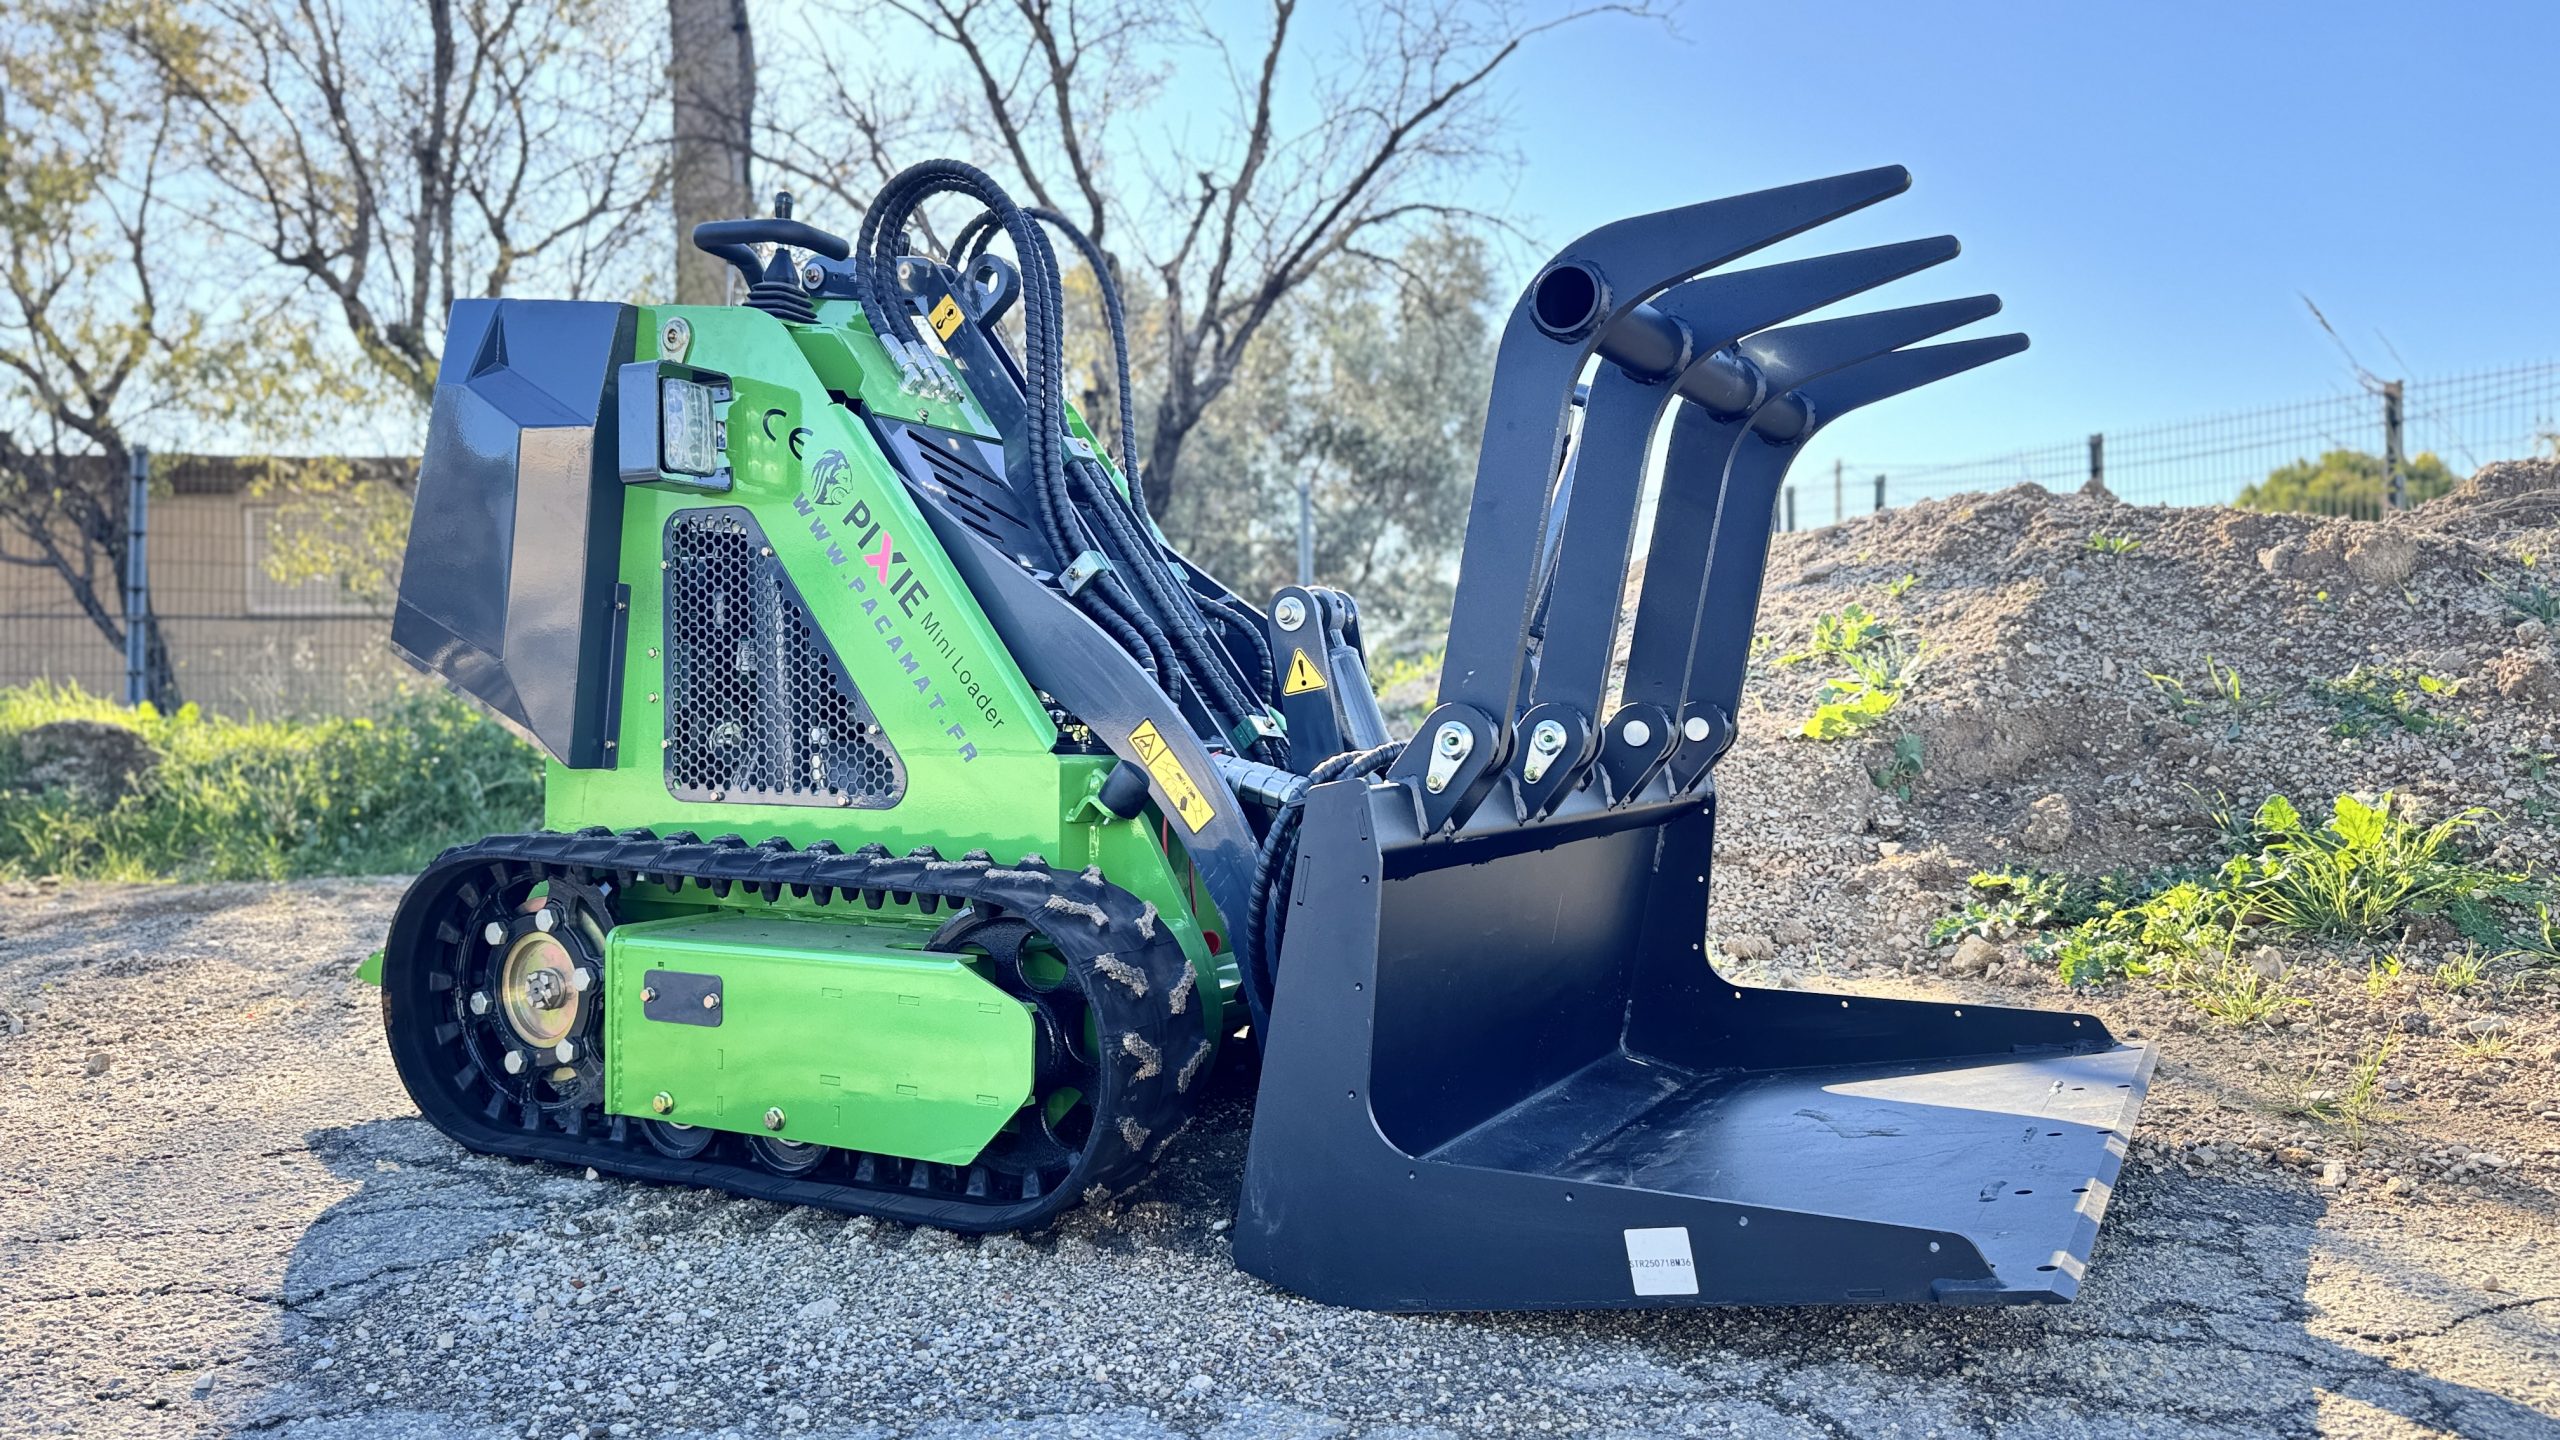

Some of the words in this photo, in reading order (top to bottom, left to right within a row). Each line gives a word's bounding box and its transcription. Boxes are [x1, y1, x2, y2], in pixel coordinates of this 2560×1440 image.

[762, 408, 813, 461] CE
[792, 492, 978, 763] WWW.PACAMAT.FR
[842, 499, 929, 619] PIXIE
[921, 611, 954, 660] Mini
[951, 656, 1005, 730] Loader
